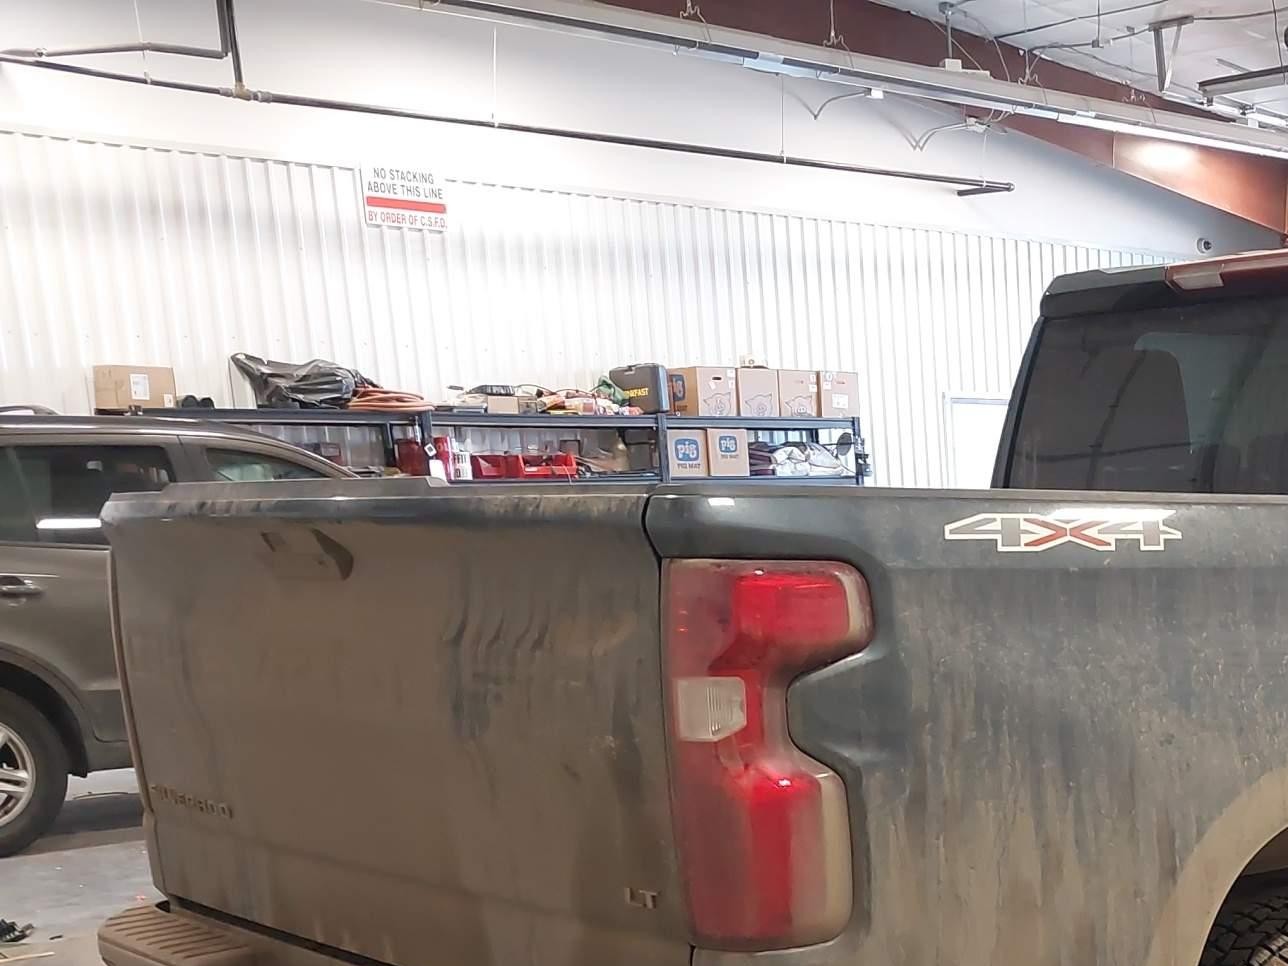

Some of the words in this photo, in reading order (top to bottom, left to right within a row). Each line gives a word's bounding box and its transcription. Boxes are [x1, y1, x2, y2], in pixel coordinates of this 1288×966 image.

[373, 168, 386, 180] NO
[389, 169, 434, 185] STACKING
[367, 181, 398, 195] ABOVE
[399, 185, 421, 198] THIS
[423, 188, 443, 200] LINE
[368, 211, 377, 221] BY
[381, 211, 406, 224] ORDER
[408, 215, 418, 226] OF
[677, 442, 697, 459] pig
[719, 438, 736, 451] pig
[624, 888, 657, 909] LT
